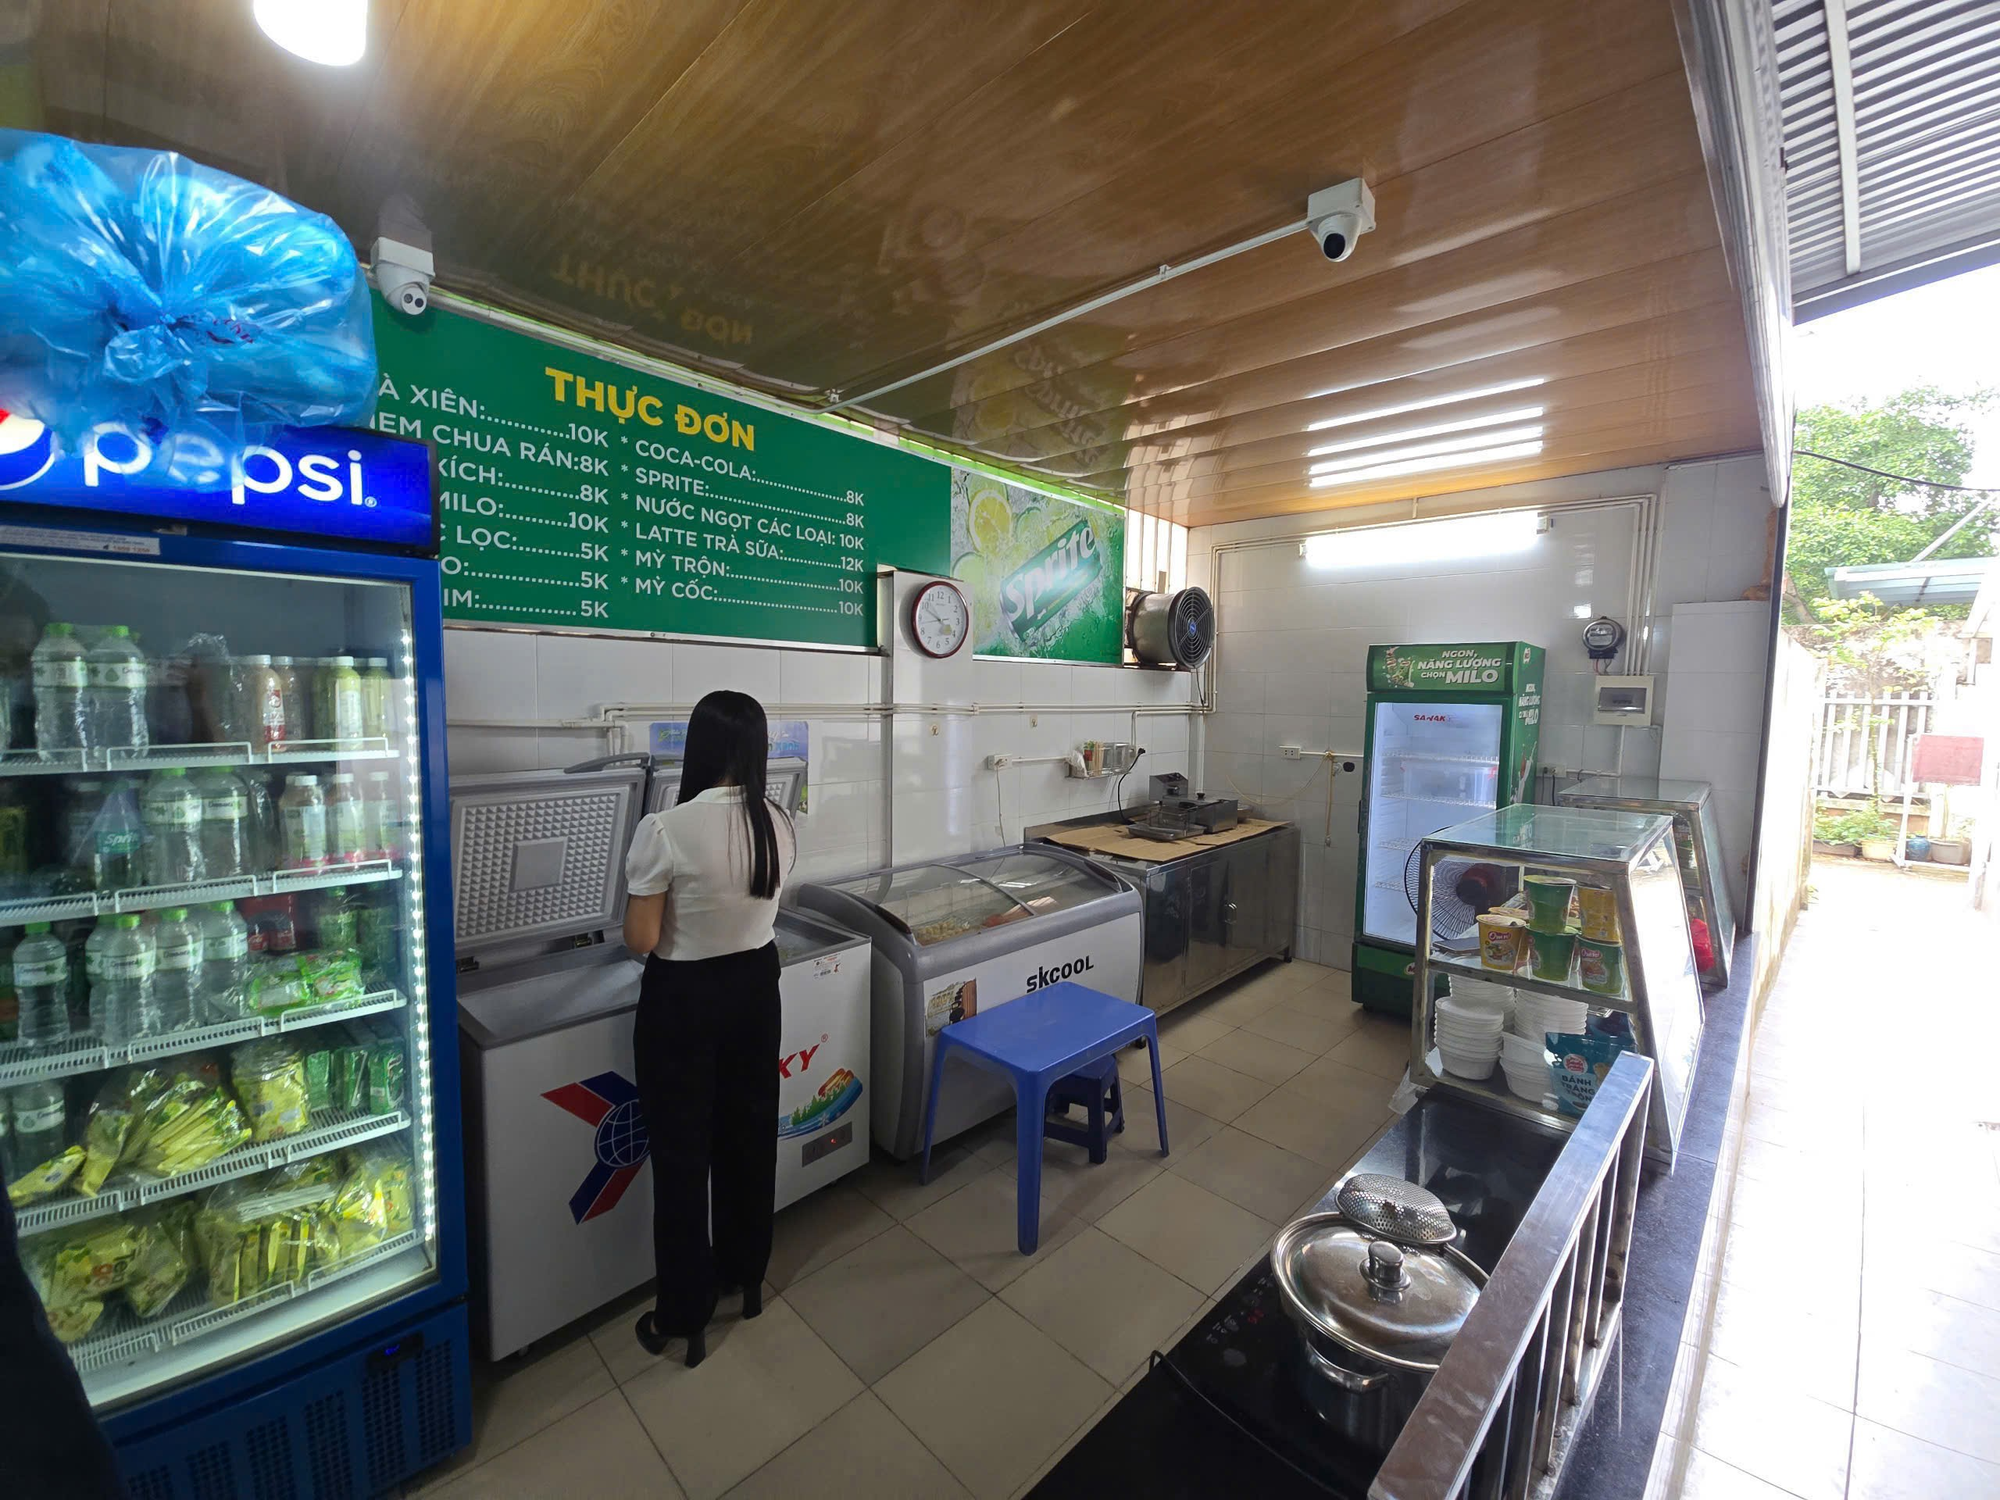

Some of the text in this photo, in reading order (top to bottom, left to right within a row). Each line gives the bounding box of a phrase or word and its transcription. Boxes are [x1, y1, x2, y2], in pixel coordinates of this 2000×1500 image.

[378, 372, 400, 400] À
[545, 366, 754, 451] THỰC ĐƠN
[432, 424, 511, 457] CHUA
[84, 421, 363, 506] pepsi
[635, 495, 864, 550] NƯỚC NGỌT CÁC LOẠI: 10K
[635, 523, 697, 547] LATTE
[703, 534, 739, 554] TRÀ
[441, 556, 468, 576] O:
[635, 549, 666, 569] MỲ
[635, 576, 666, 595] MỲ
[1006, 527, 1096, 622] Sprite
[443, 588, 609, 618] IM: 5K
[1417, 657, 1502, 669] NĂNG LƯỢNG
[1420, 669, 1499, 684] CHỌN MILO
[104, 832, 138, 846] Spri
[779, 1043, 820, 1079] KY
